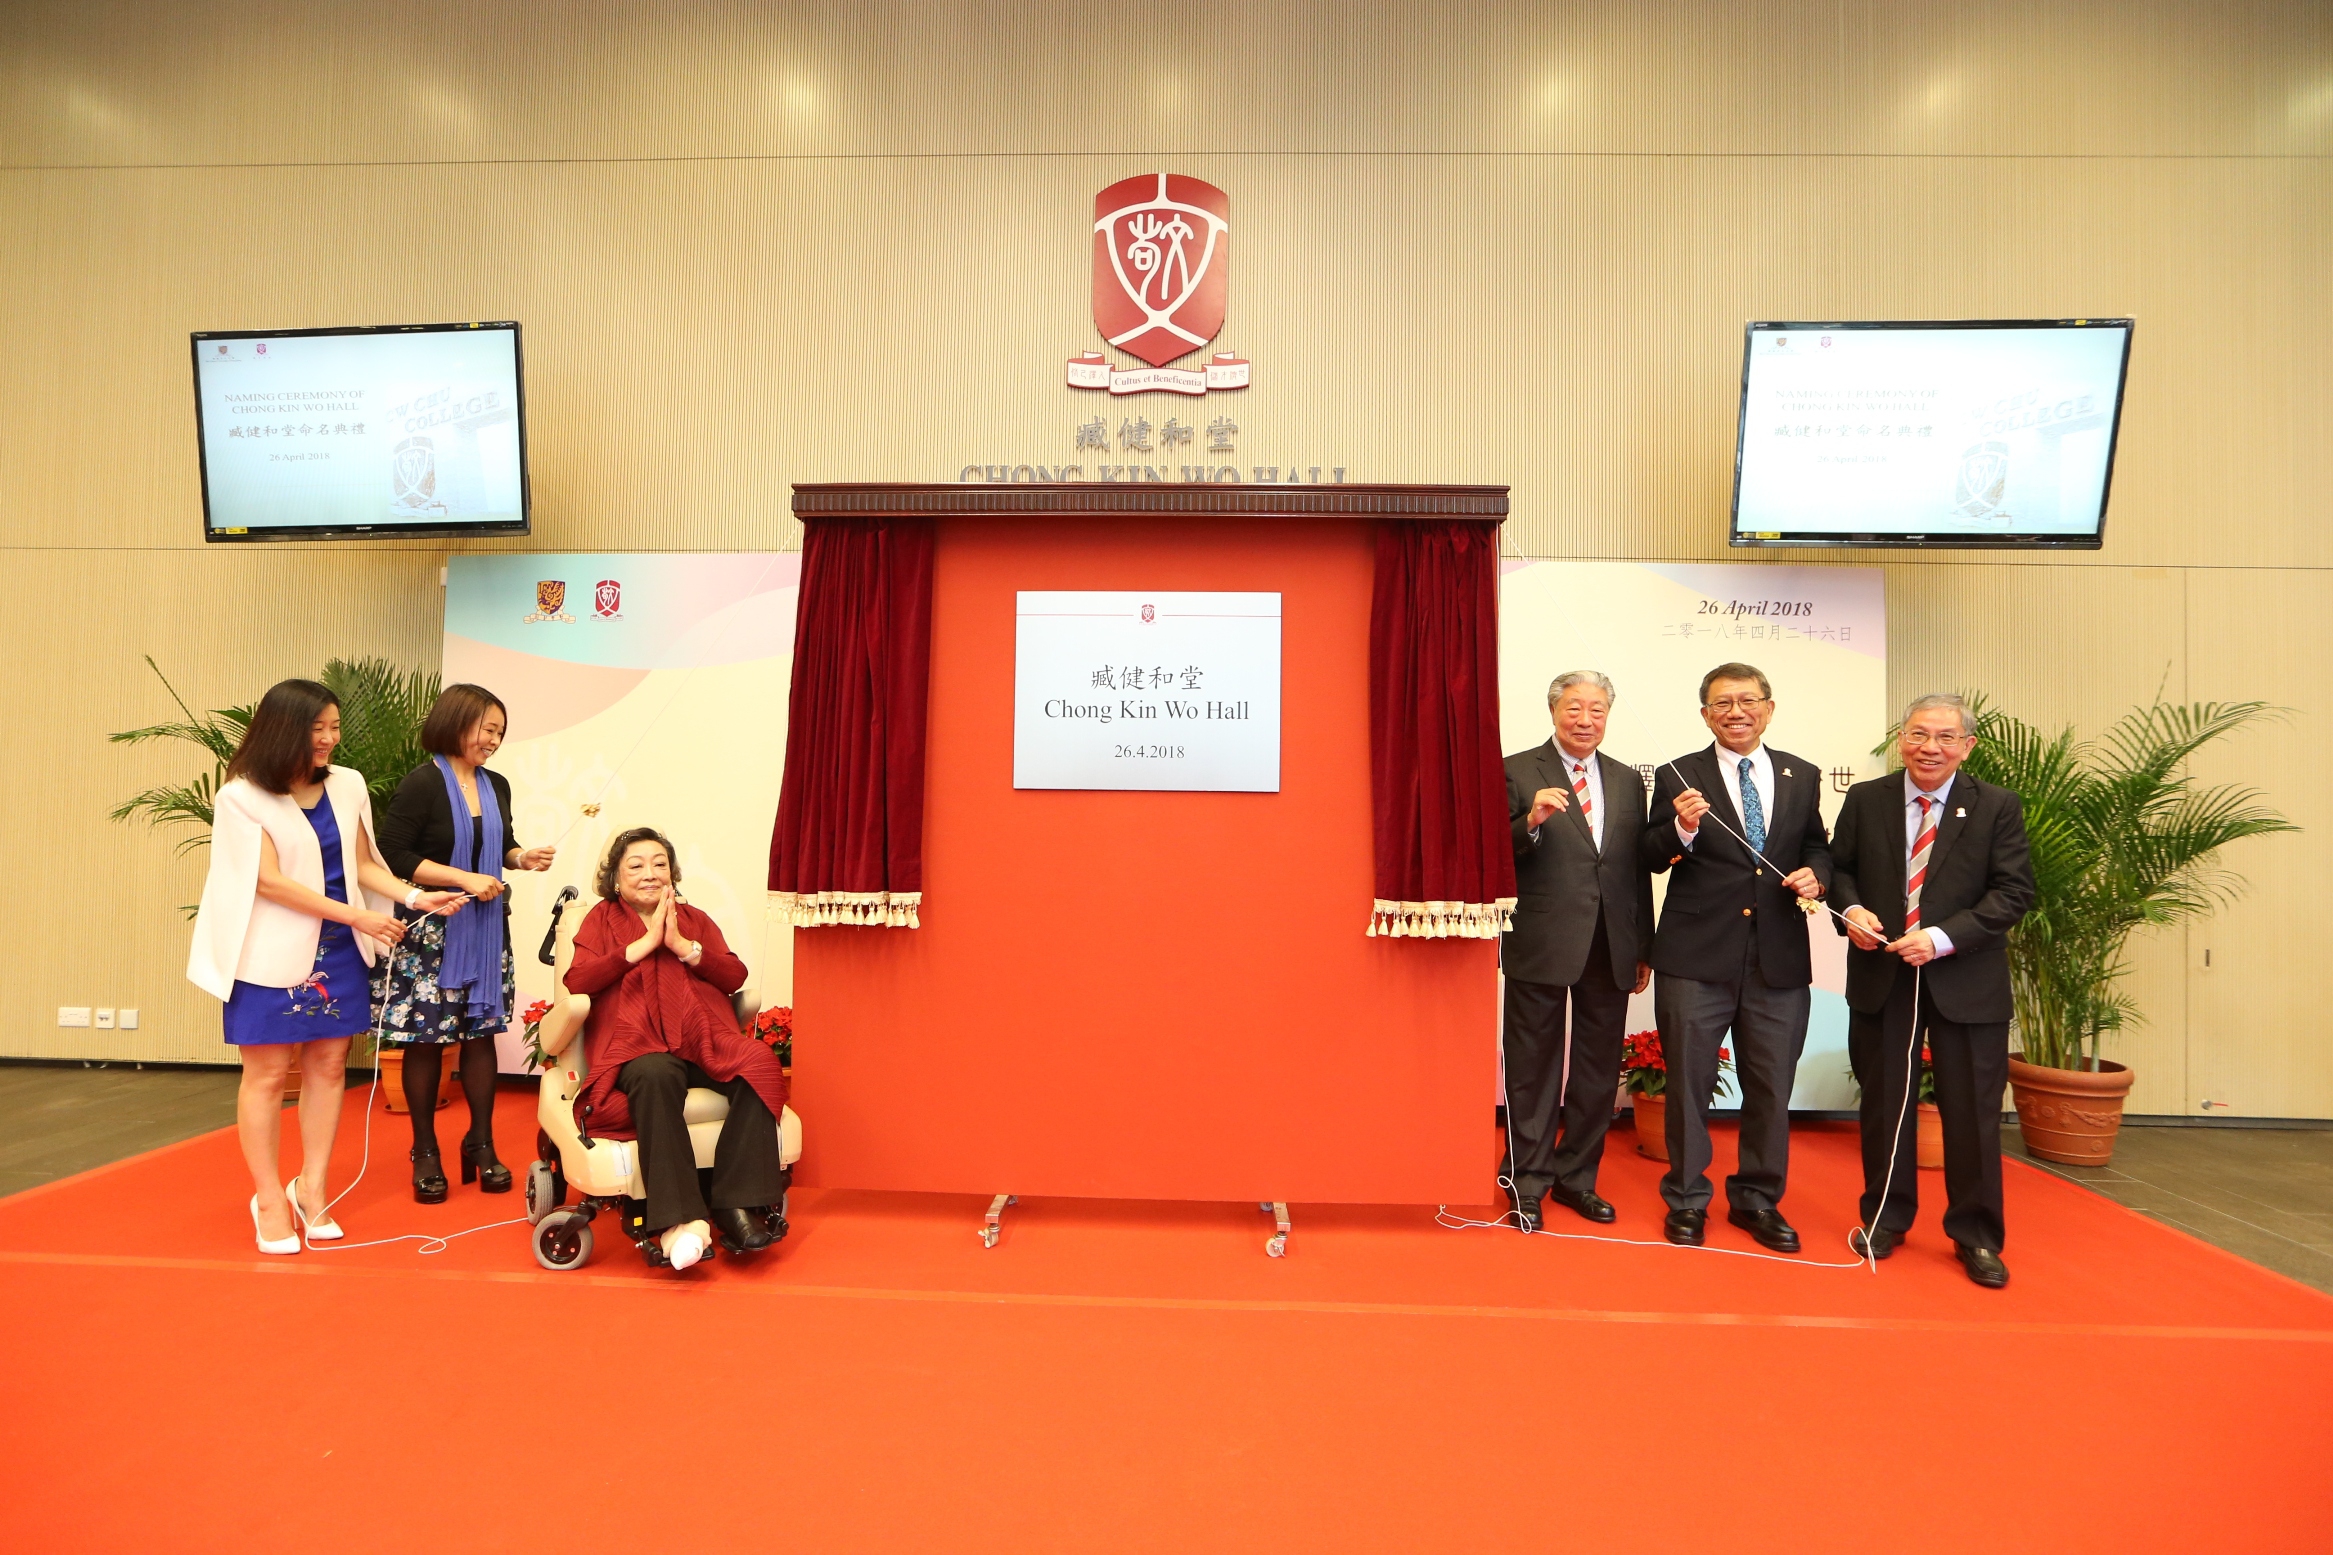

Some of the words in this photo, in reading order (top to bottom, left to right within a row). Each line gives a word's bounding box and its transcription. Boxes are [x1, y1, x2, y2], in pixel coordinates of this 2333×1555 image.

[1114, 376, 1141, 387] Cultus
[1144, 375, 1151, 383] et
[1153, 374, 1202, 387] Beneficentia
[224, 393, 275, 402] NAMING
[277, 391, 347, 401] CEREMONY
[349, 390, 365, 399] OF
[1775, 390, 1834, 399] NAMING
[1920, 389, 1939, 399] OF
[232, 404, 276, 415] CHONG
[278, 404, 300, 413] KIN
[303, 403, 324, 412] WO
[327, 402, 360, 411] HALL
[404, 391, 500, 433] COLLEGE
[1781, 403, 1832, 412] CHONG
[1836, 403, 1861, 411] KIN
[1865, 403, 1888, 411] WO
[1979, 393, 2096, 438] COLLEGE
[228, 422, 367, 439] 臧健和堂命名典禮
[1076, 415, 1239, 451] 臧健和堂
[269, 453, 281, 462] 26
[282, 453, 304, 462] April
[308, 452, 330, 461] 2018
[1817, 455, 1830, 463] 26
[1862, 455, 1888, 463] 2018
[1697, 600, 1718, 615] 26
[1721, 599, 1768, 621] April
[1770, 601, 1813, 617] 2018
[1661, 622, 1852, 642] 二零一八年四月二十六日
[1090, 664, 1204, 691] 臧健和堂
[1044, 699, 1112, 723] Chong
[1119, 700, 1158, 719] Kin
[1164, 700, 1199, 720] Wo
[1206, 701, 1249, 720] Hall
[1114, 744, 1186, 759] 26.4.2018
